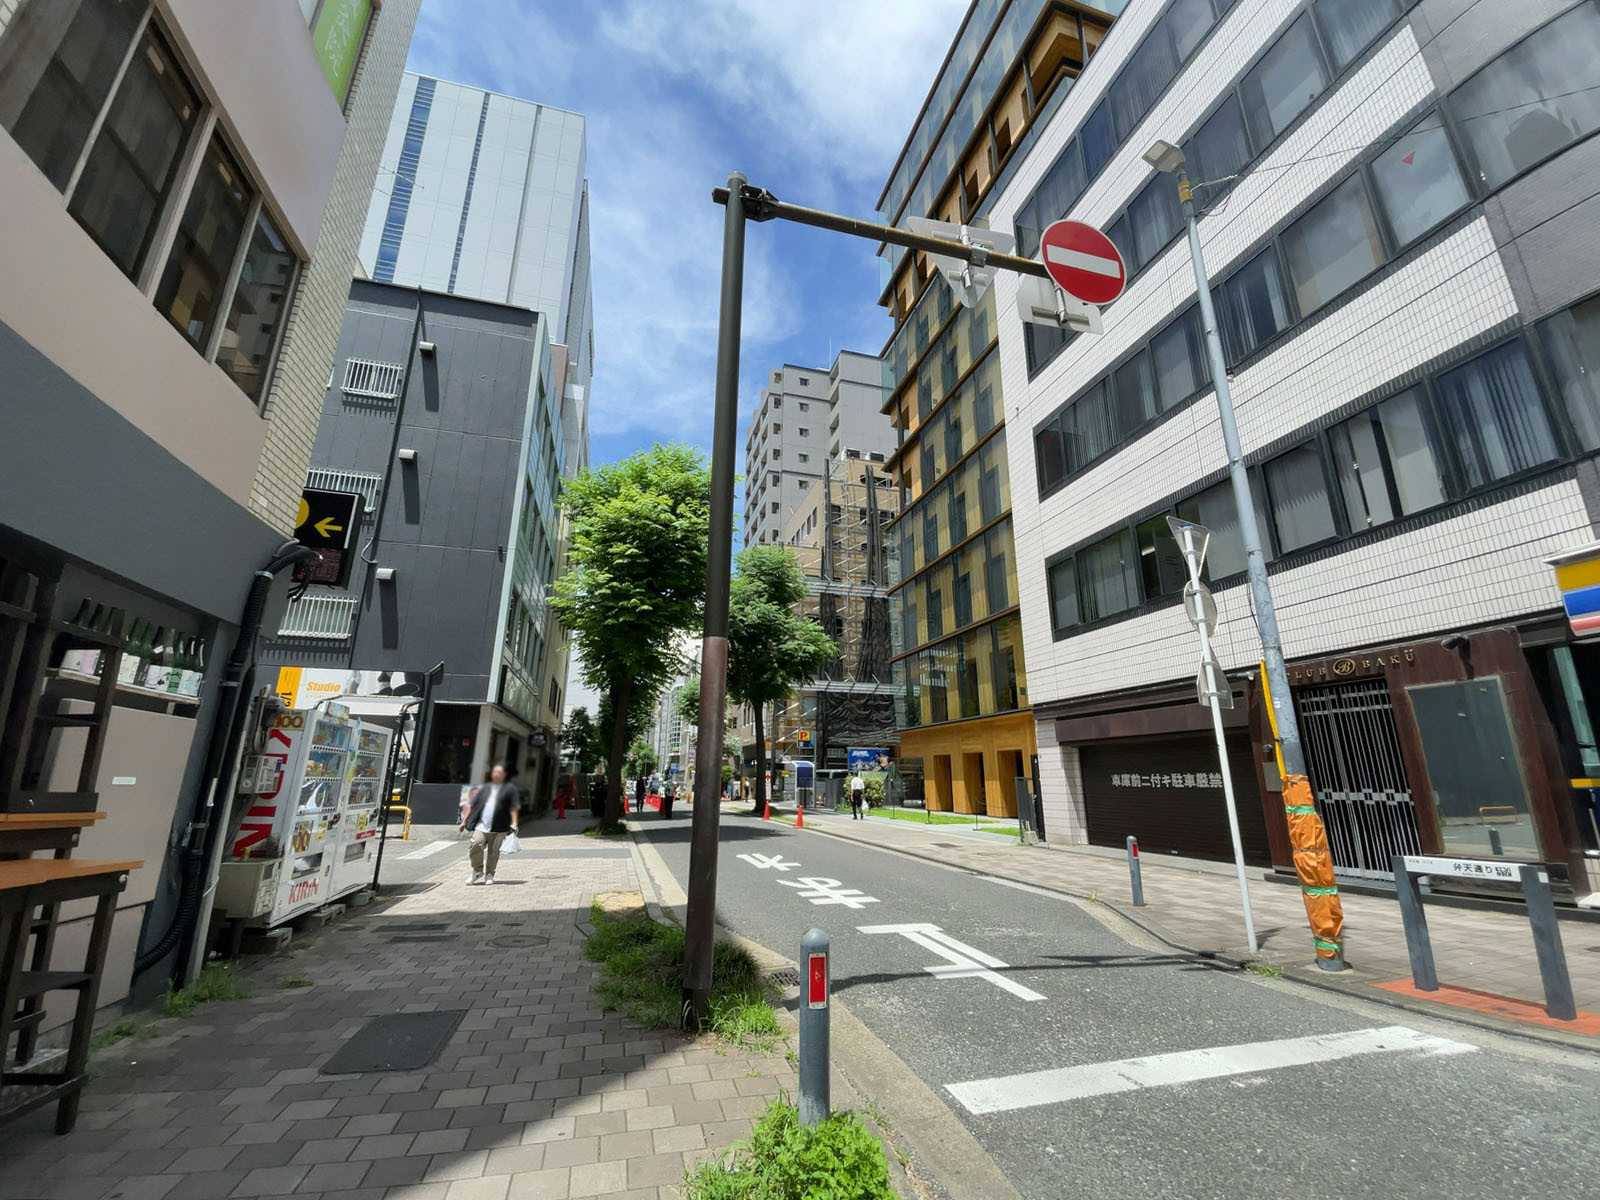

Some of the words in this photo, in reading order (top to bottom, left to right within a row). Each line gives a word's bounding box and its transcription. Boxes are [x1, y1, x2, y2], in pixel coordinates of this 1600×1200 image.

[1286, 667, 1328, 679] LUB
[306, 681, 341, 692] Studio
[1453, 862, 1493, 874] 弁天通り
[288, 877, 319, 905] KIRIN
